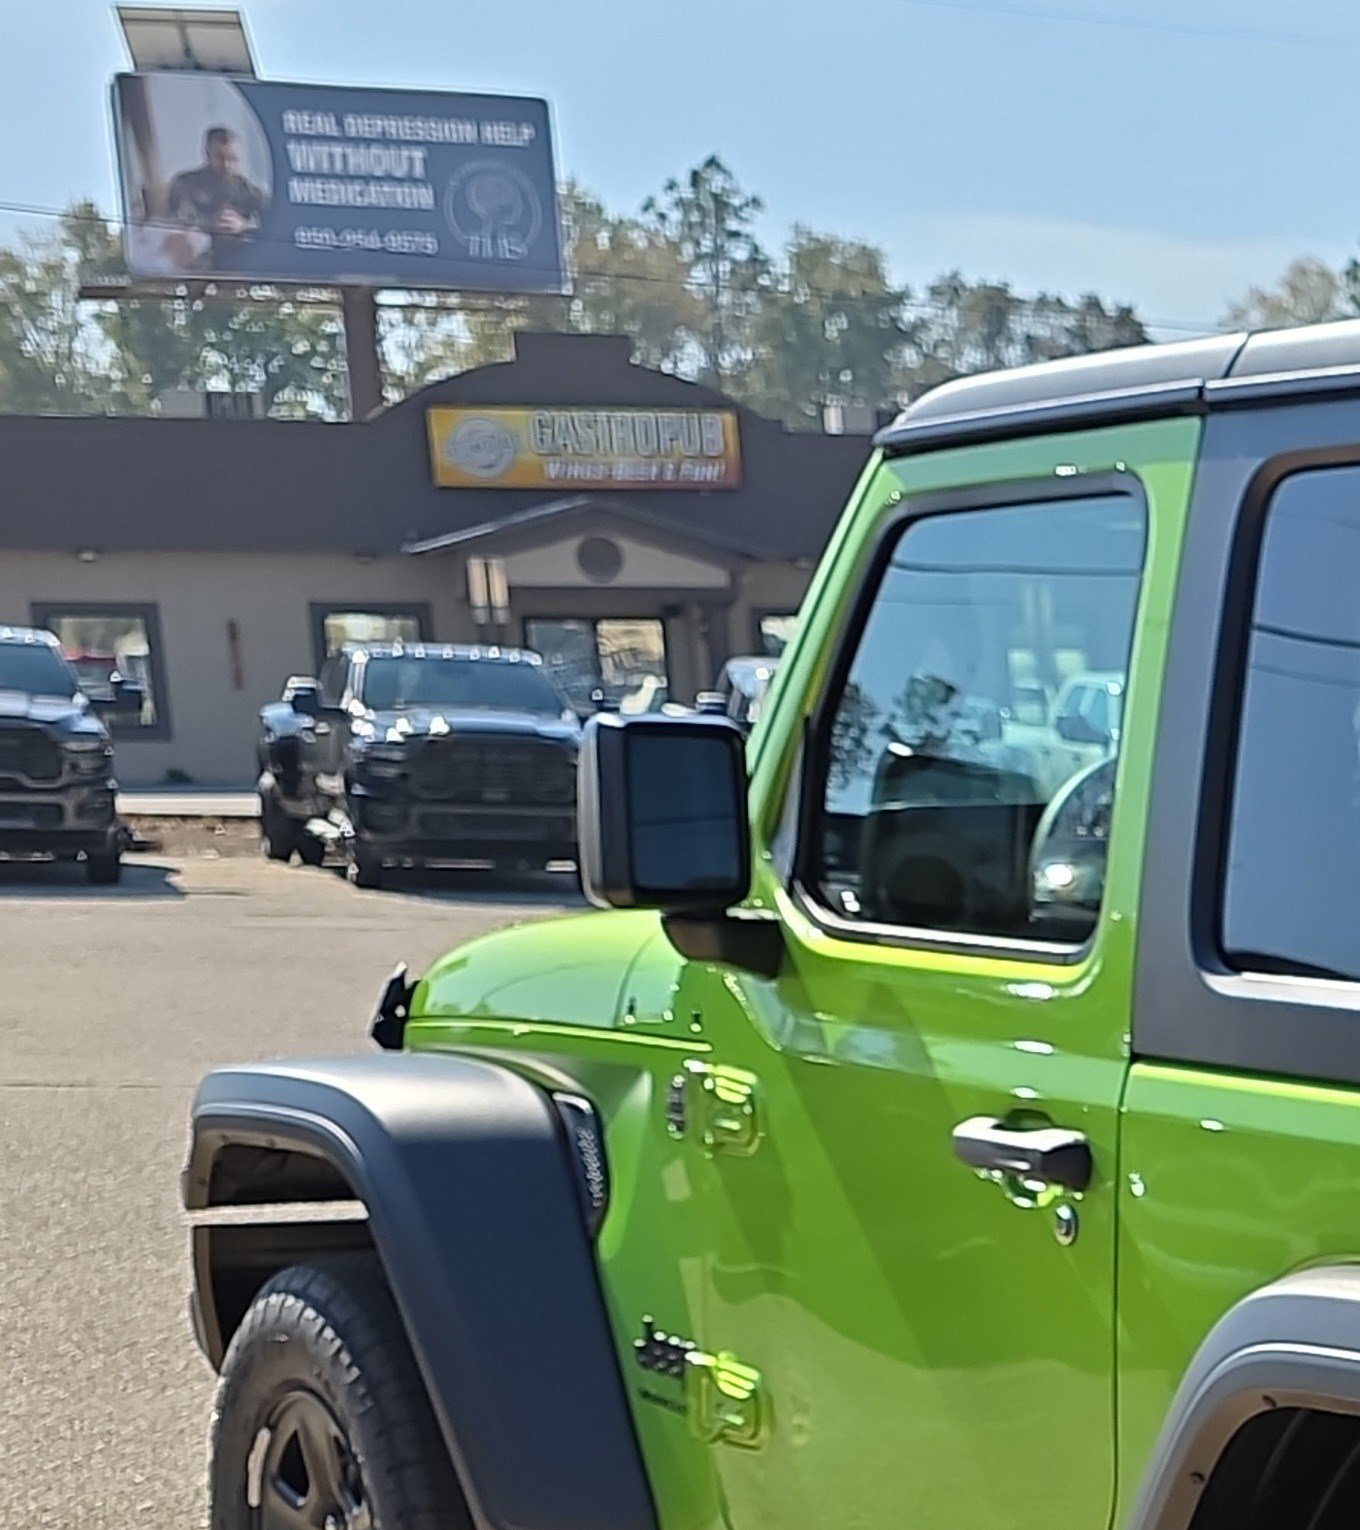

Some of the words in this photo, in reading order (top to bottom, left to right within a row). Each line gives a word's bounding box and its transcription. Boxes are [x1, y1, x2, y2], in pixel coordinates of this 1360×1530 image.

[282, 110, 339, 136] REAL
[343, 113, 478, 144] DEPRESSION
[479, 120, 536, 147] HELP
[285, 140, 428, 179] WITHOUT
[288, 176, 435, 211] MEDICATION
